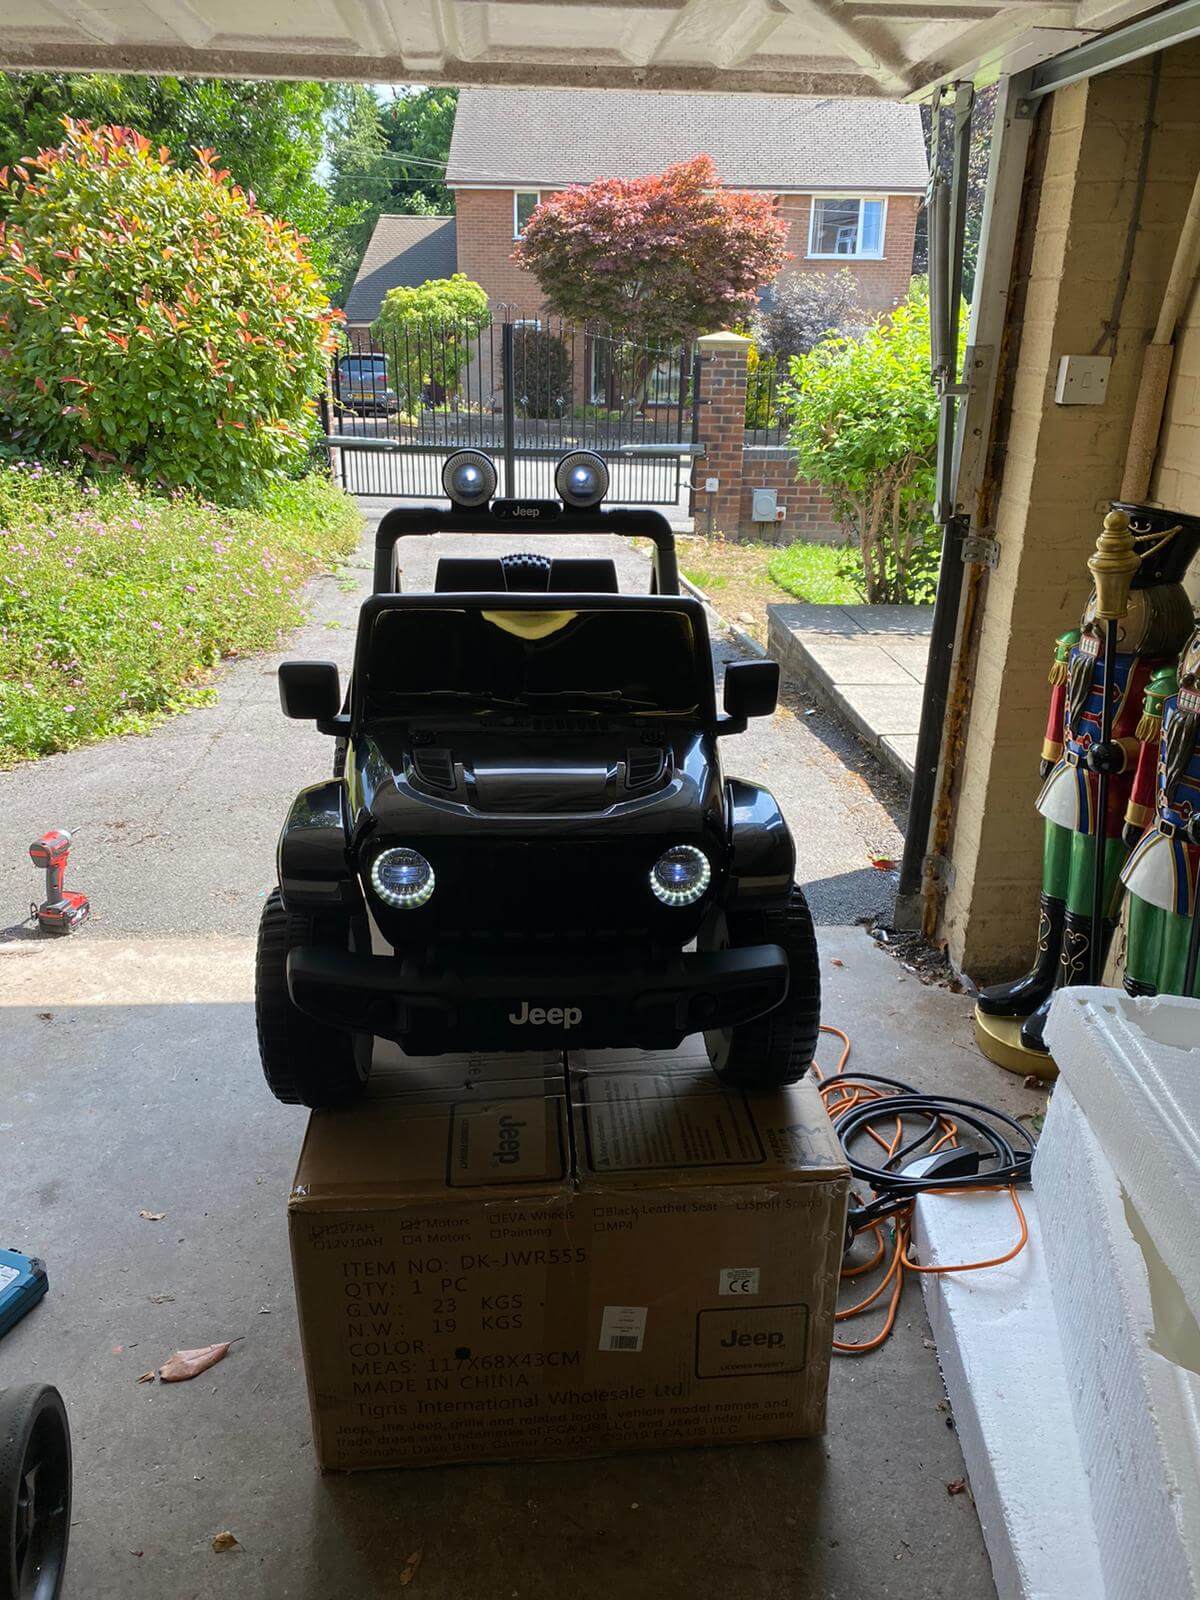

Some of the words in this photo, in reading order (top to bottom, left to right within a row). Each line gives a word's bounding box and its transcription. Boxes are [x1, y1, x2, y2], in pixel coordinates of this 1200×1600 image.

[512, 506, 540, 518] Jeep
[508, 1002, 582, 1029] Jeep
[493, 1115, 527, 1164] Jeep
[604, 1205, 638, 1217] Black
[643, 1202, 687, 1215] Leather
[691, 1202, 717, 1212] Seat
[748, 1199, 781, 1212] Sport
[427, 1216, 471, 1229] Motors
[500, 1212, 526, 1225] EVA
[607, 1220, 634, 1231] MP4
[427, 1231, 472, 1243] Motors
[502, 1226, 553, 1239] Painting
[343, 1262, 396, 1277] ITEM
[407, 1258, 449, 1274] NO:
[460, 1247, 587, 1271] DK-JWR555
[344, 1282, 396, 1298] QTY:
[412, 1279, 424, 1295] 1
[441, 1277, 469, 1292] PC
[729, 1279, 750, 1293] CE
[432, 1298, 458, 1313] 23
[481, 1294, 523, 1310] KGS
[432, 1318, 458, 1334] 19
[481, 1314, 523, 1330] KGS
[349, 1339, 432, 1357] COLOR:
[720, 1329, 786, 1350] Jeep
[351, 1360, 418, 1377] MEAS:
[428, 1351, 581, 1373] 117X68X43CM
[352, 1378, 417, 1395] MADE
[424, 1377, 449, 1392] IN
[459, 1373, 530, 1390] CHINA
[358, 1400, 408, 1419] Tigris
[416, 1393, 540, 1415] International
[548, 1385, 648, 1406] Wholesale
[489, 1417, 514, 1426] and
[670, 1404, 711, 1415] model
[715, 1401, 760, 1412] names
[764, 1398, 789, 1409] and
[638, 1418, 663, 1429] and
[668, 1415, 700, 1427] used
[705, 1412, 743, 1424] under
[747, 1409, 795, 1421] license
